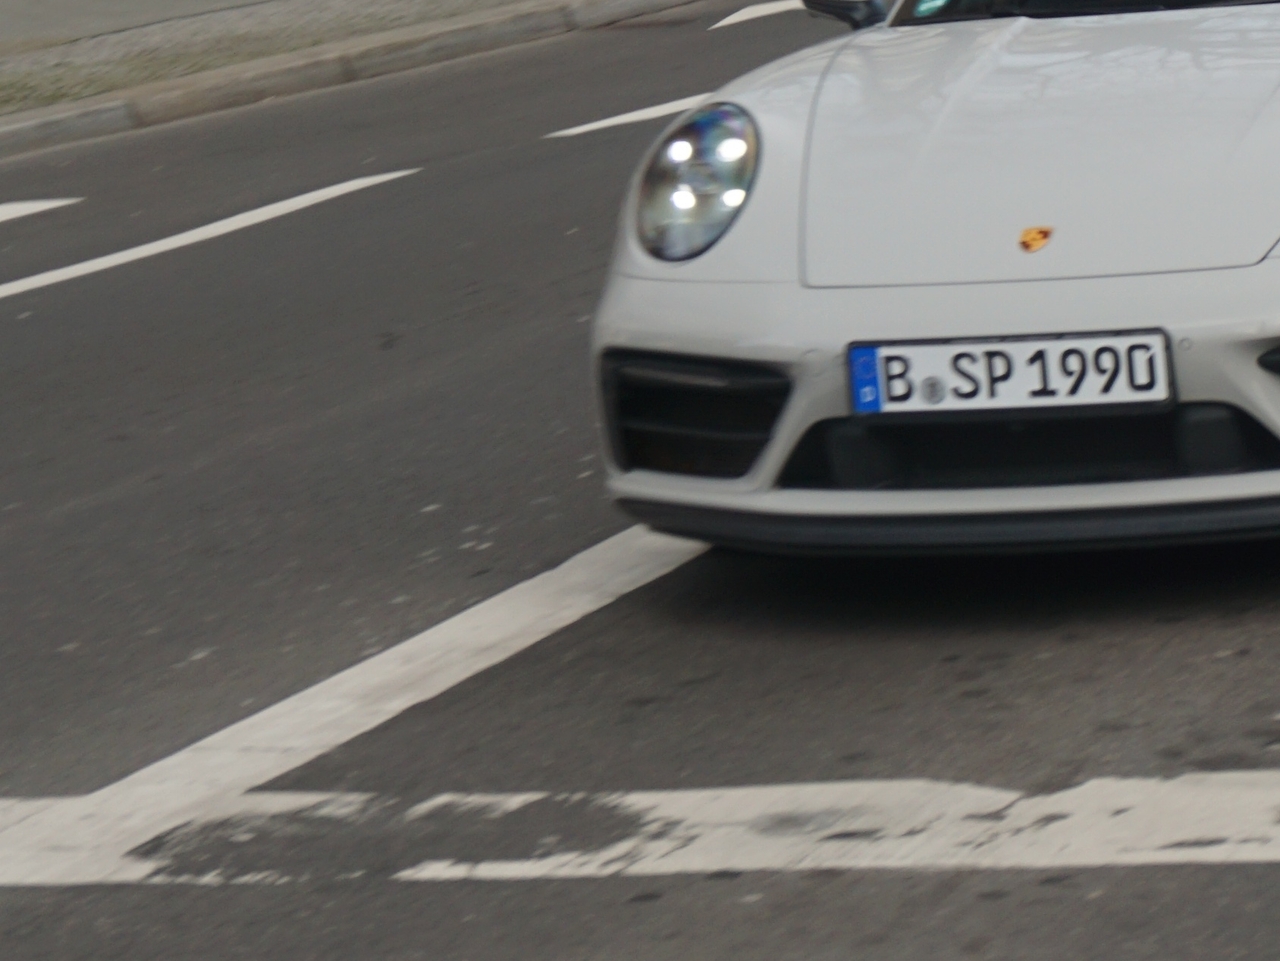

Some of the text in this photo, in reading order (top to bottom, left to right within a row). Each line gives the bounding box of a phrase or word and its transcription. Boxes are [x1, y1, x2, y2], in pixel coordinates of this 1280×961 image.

[882, 344, 1157, 402] B SP 1990
